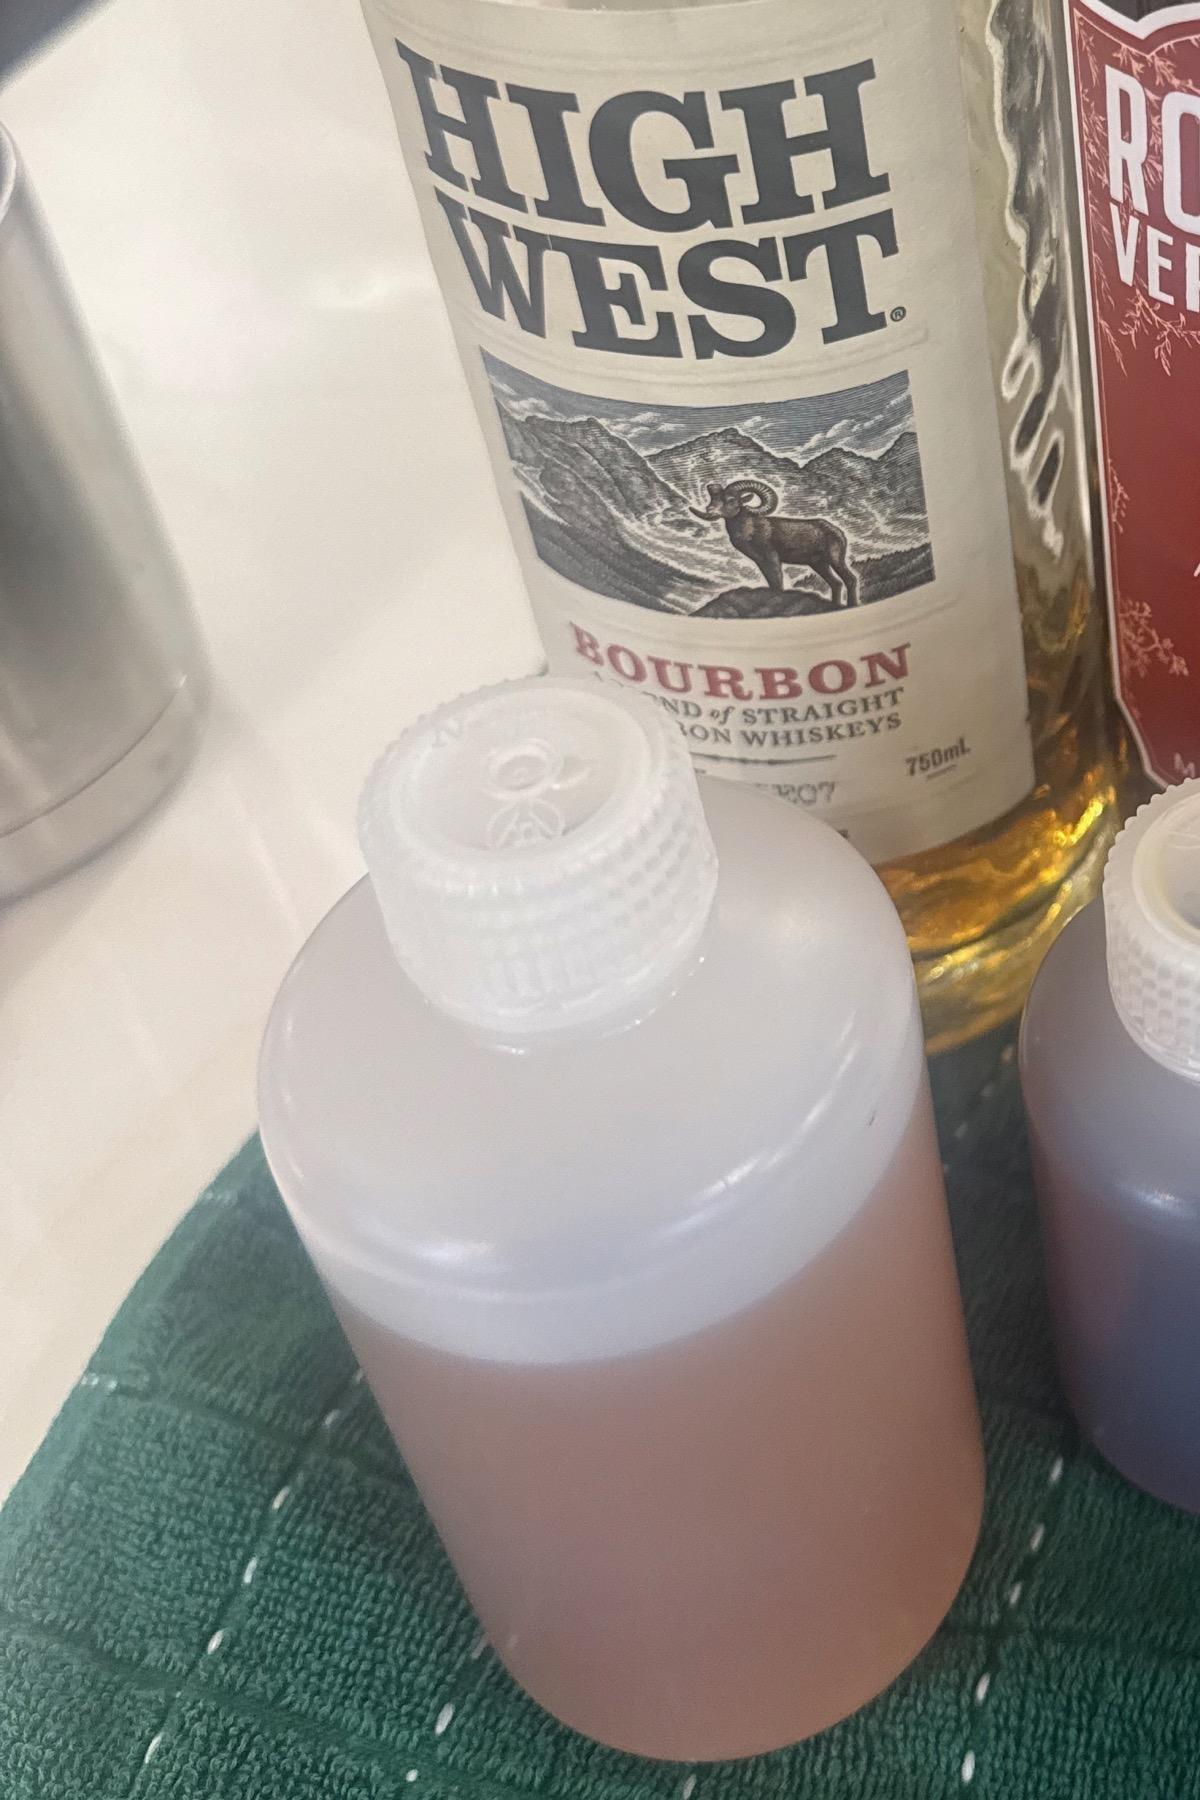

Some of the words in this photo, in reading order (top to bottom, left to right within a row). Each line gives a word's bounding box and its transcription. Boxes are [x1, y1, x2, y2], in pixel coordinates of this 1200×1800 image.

[395, 37, 890, 233] HIGH
[570, 621, 912, 701] BOURBON
[710, 705, 736, 726] of
[742, 687, 906, 726] STRAIGHT
[737, 711, 903, 747] WHISKEYS
[906, 738, 972, 777] 750mL
